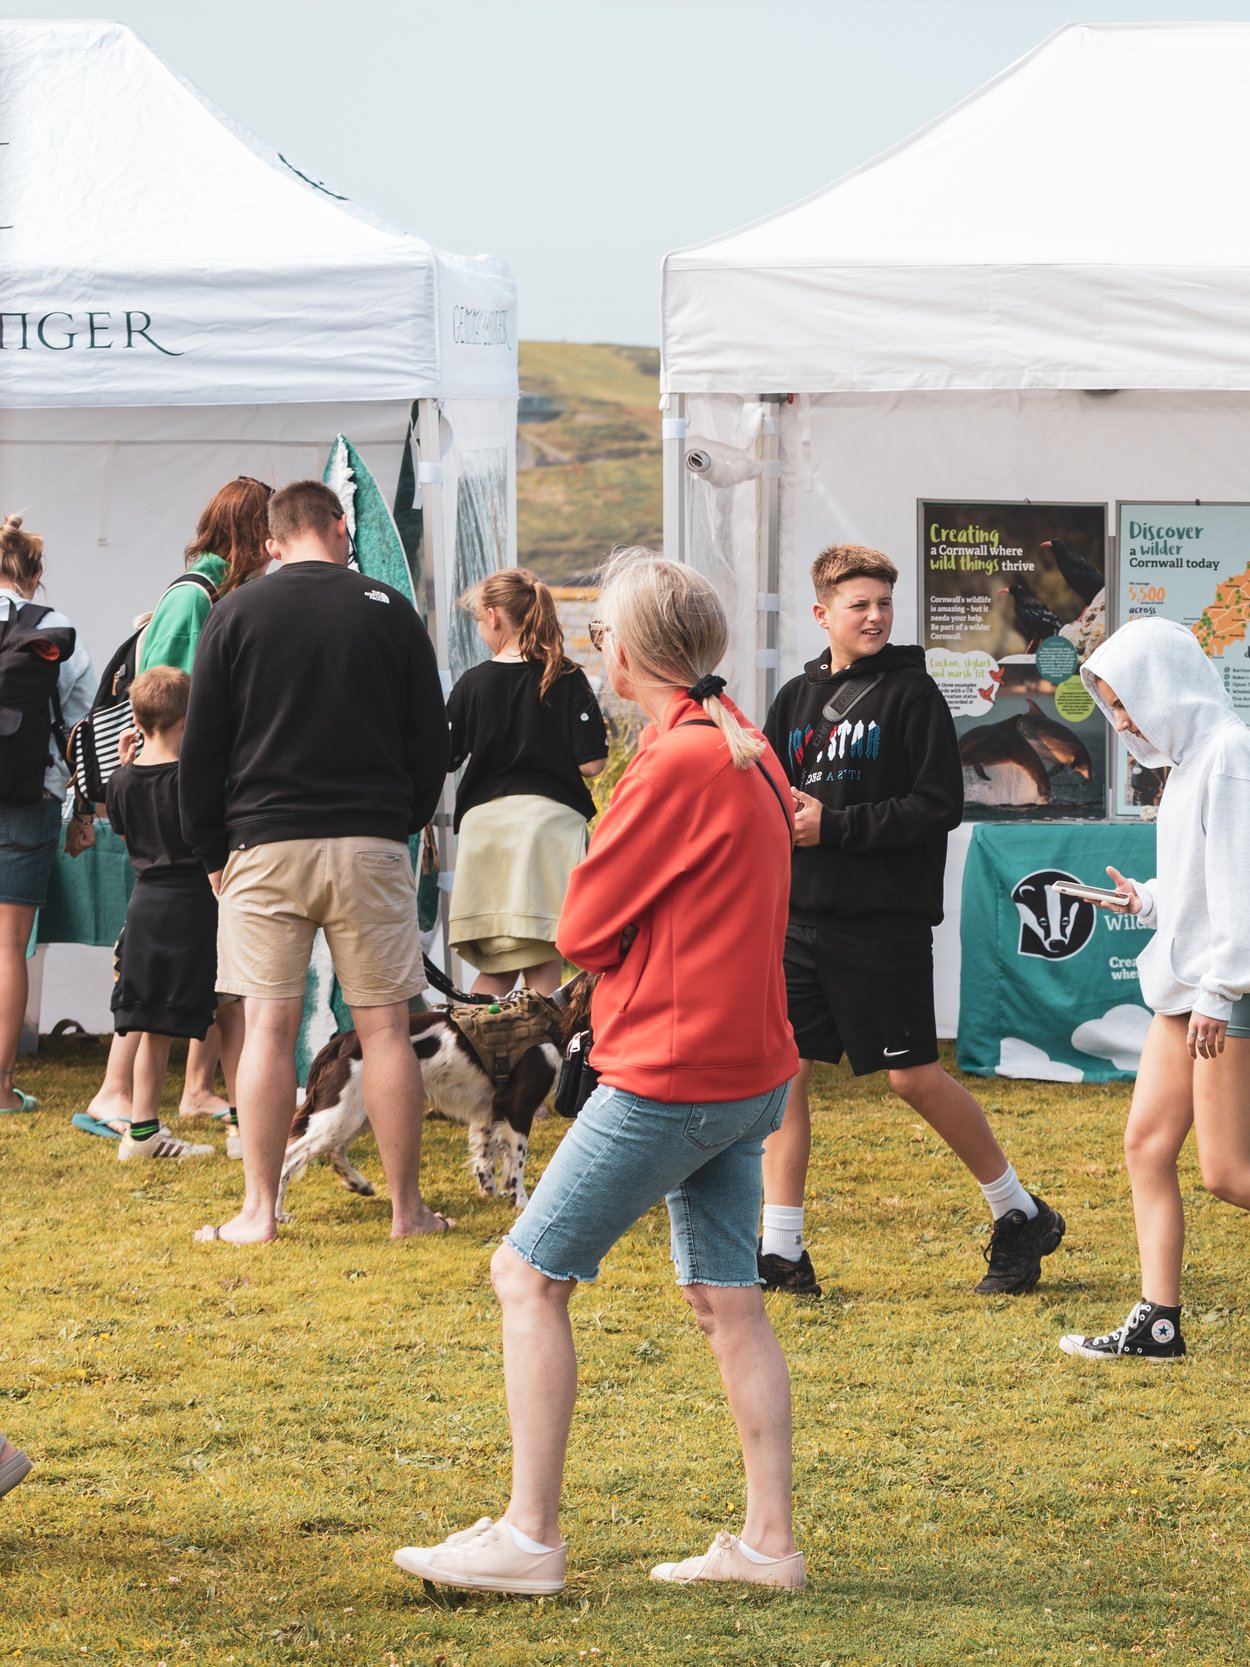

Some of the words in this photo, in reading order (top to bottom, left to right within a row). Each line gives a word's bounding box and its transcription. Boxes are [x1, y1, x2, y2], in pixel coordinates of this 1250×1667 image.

[930, 523, 999, 549] Creating
[1129, 521, 1204, 541] Discover
[939, 545, 987, 555] Cornwall
[990, 545, 1024, 555] where
[1129, 548, 1136, 556] a
[1140, 540, 1183, 556] wilder
[930, 555, 956, 570] wild
[960, 556, 999, 576] things
[1002, 560, 1035, 571] thrive
[1129, 557, 1183, 568] Cornwall
[1186, 558, 1220, 571] today
[1128, 586, 1166, 603] 5,500
[930, 596, 965, 604] Cornwall's
[966, 596, 991, 604] wildlife
[937, 605, 966, 615] amazing
[1129, 606, 1156, 614] across
[951, 615, 966, 623] your
[940, 624, 954, 632] part
[930, 669, 945, 678] and
[948, 669, 972, 678] marsh
[975, 669, 985, 678] tit
